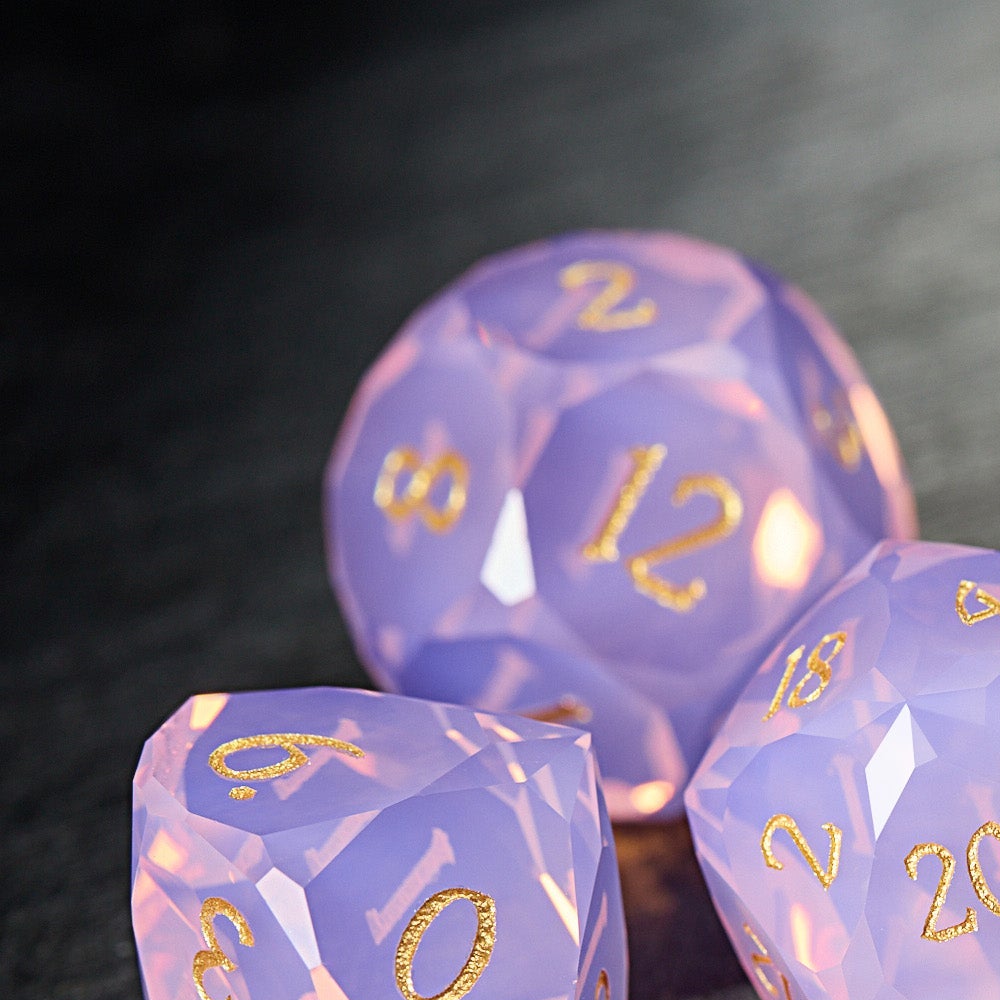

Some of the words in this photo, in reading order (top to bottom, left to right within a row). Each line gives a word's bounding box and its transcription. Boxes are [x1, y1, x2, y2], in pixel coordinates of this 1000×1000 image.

[560, 260, 657, 332] 2
[374, 445, 469, 535] 8
[581, 443, 743, 612] 12
[762, 632, 846, 722] 18
[761, 814, 842, 891] 2
